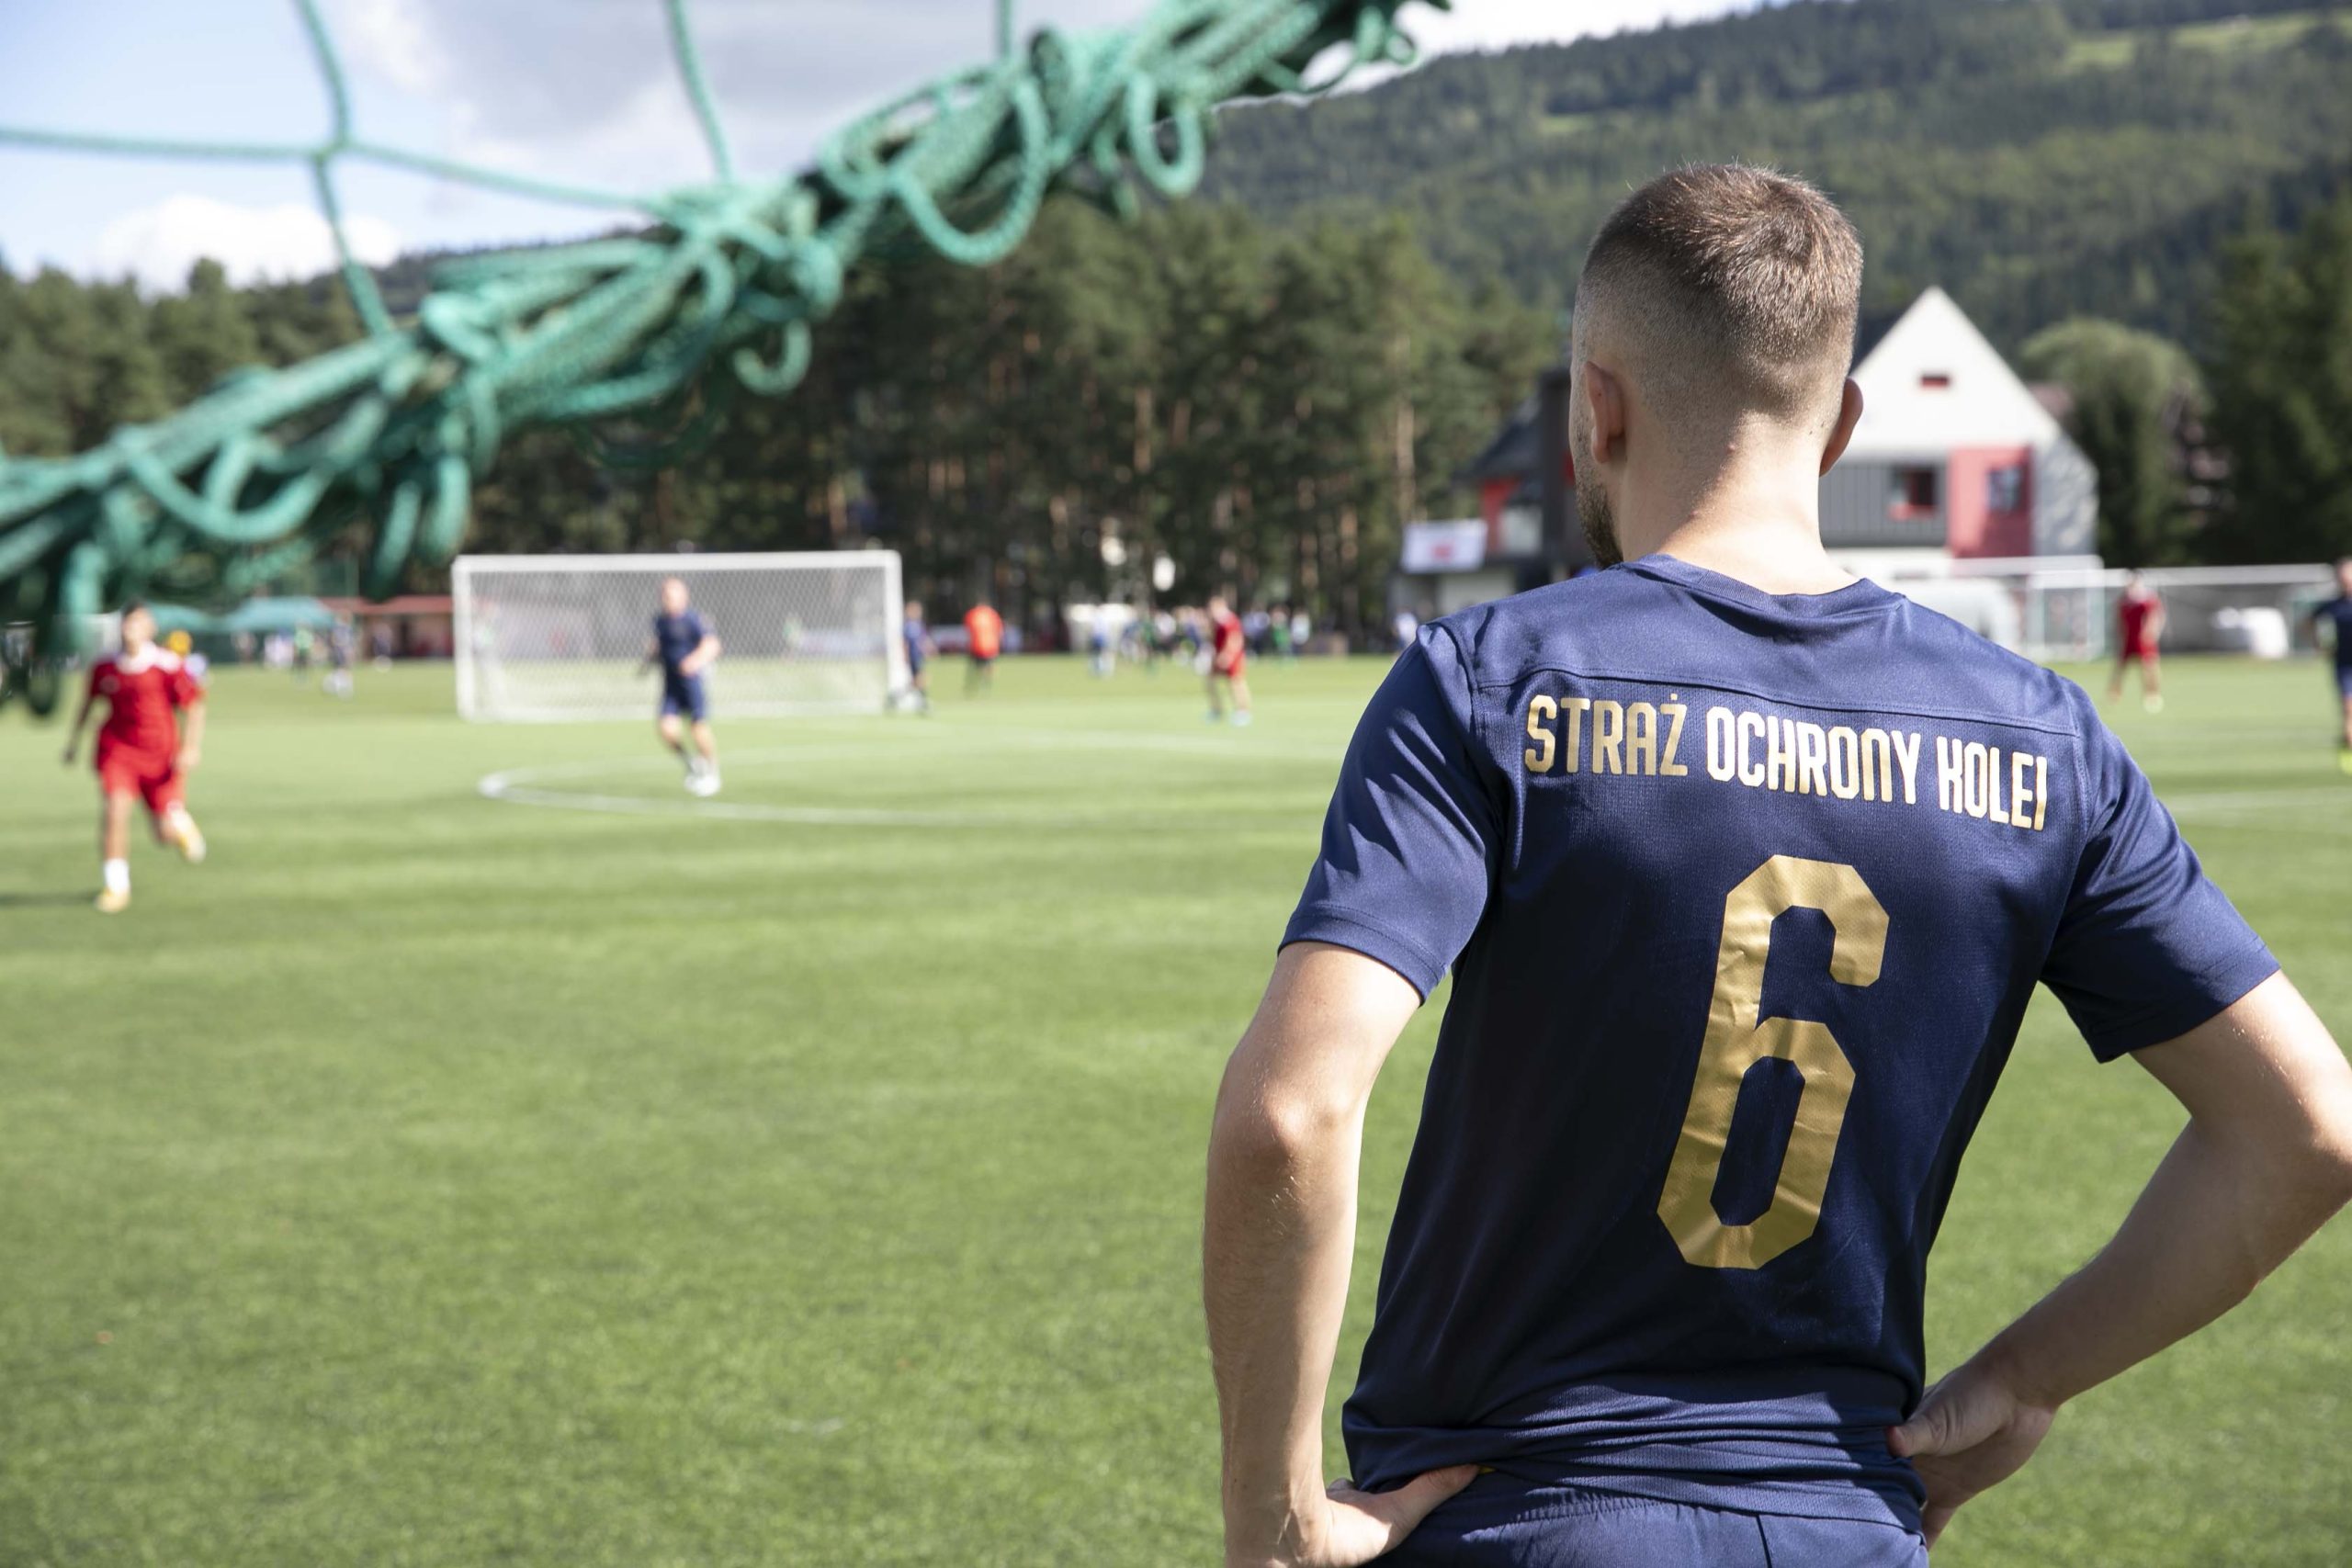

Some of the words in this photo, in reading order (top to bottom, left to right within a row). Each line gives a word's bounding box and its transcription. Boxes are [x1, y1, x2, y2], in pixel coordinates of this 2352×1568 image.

[1524, 694, 1689, 776] STRAŻ
[1706, 705, 1921, 805] OCHRONY
[1936, 736, 2048, 831] KOLEI
[1657, 854, 1890, 1269] 6
